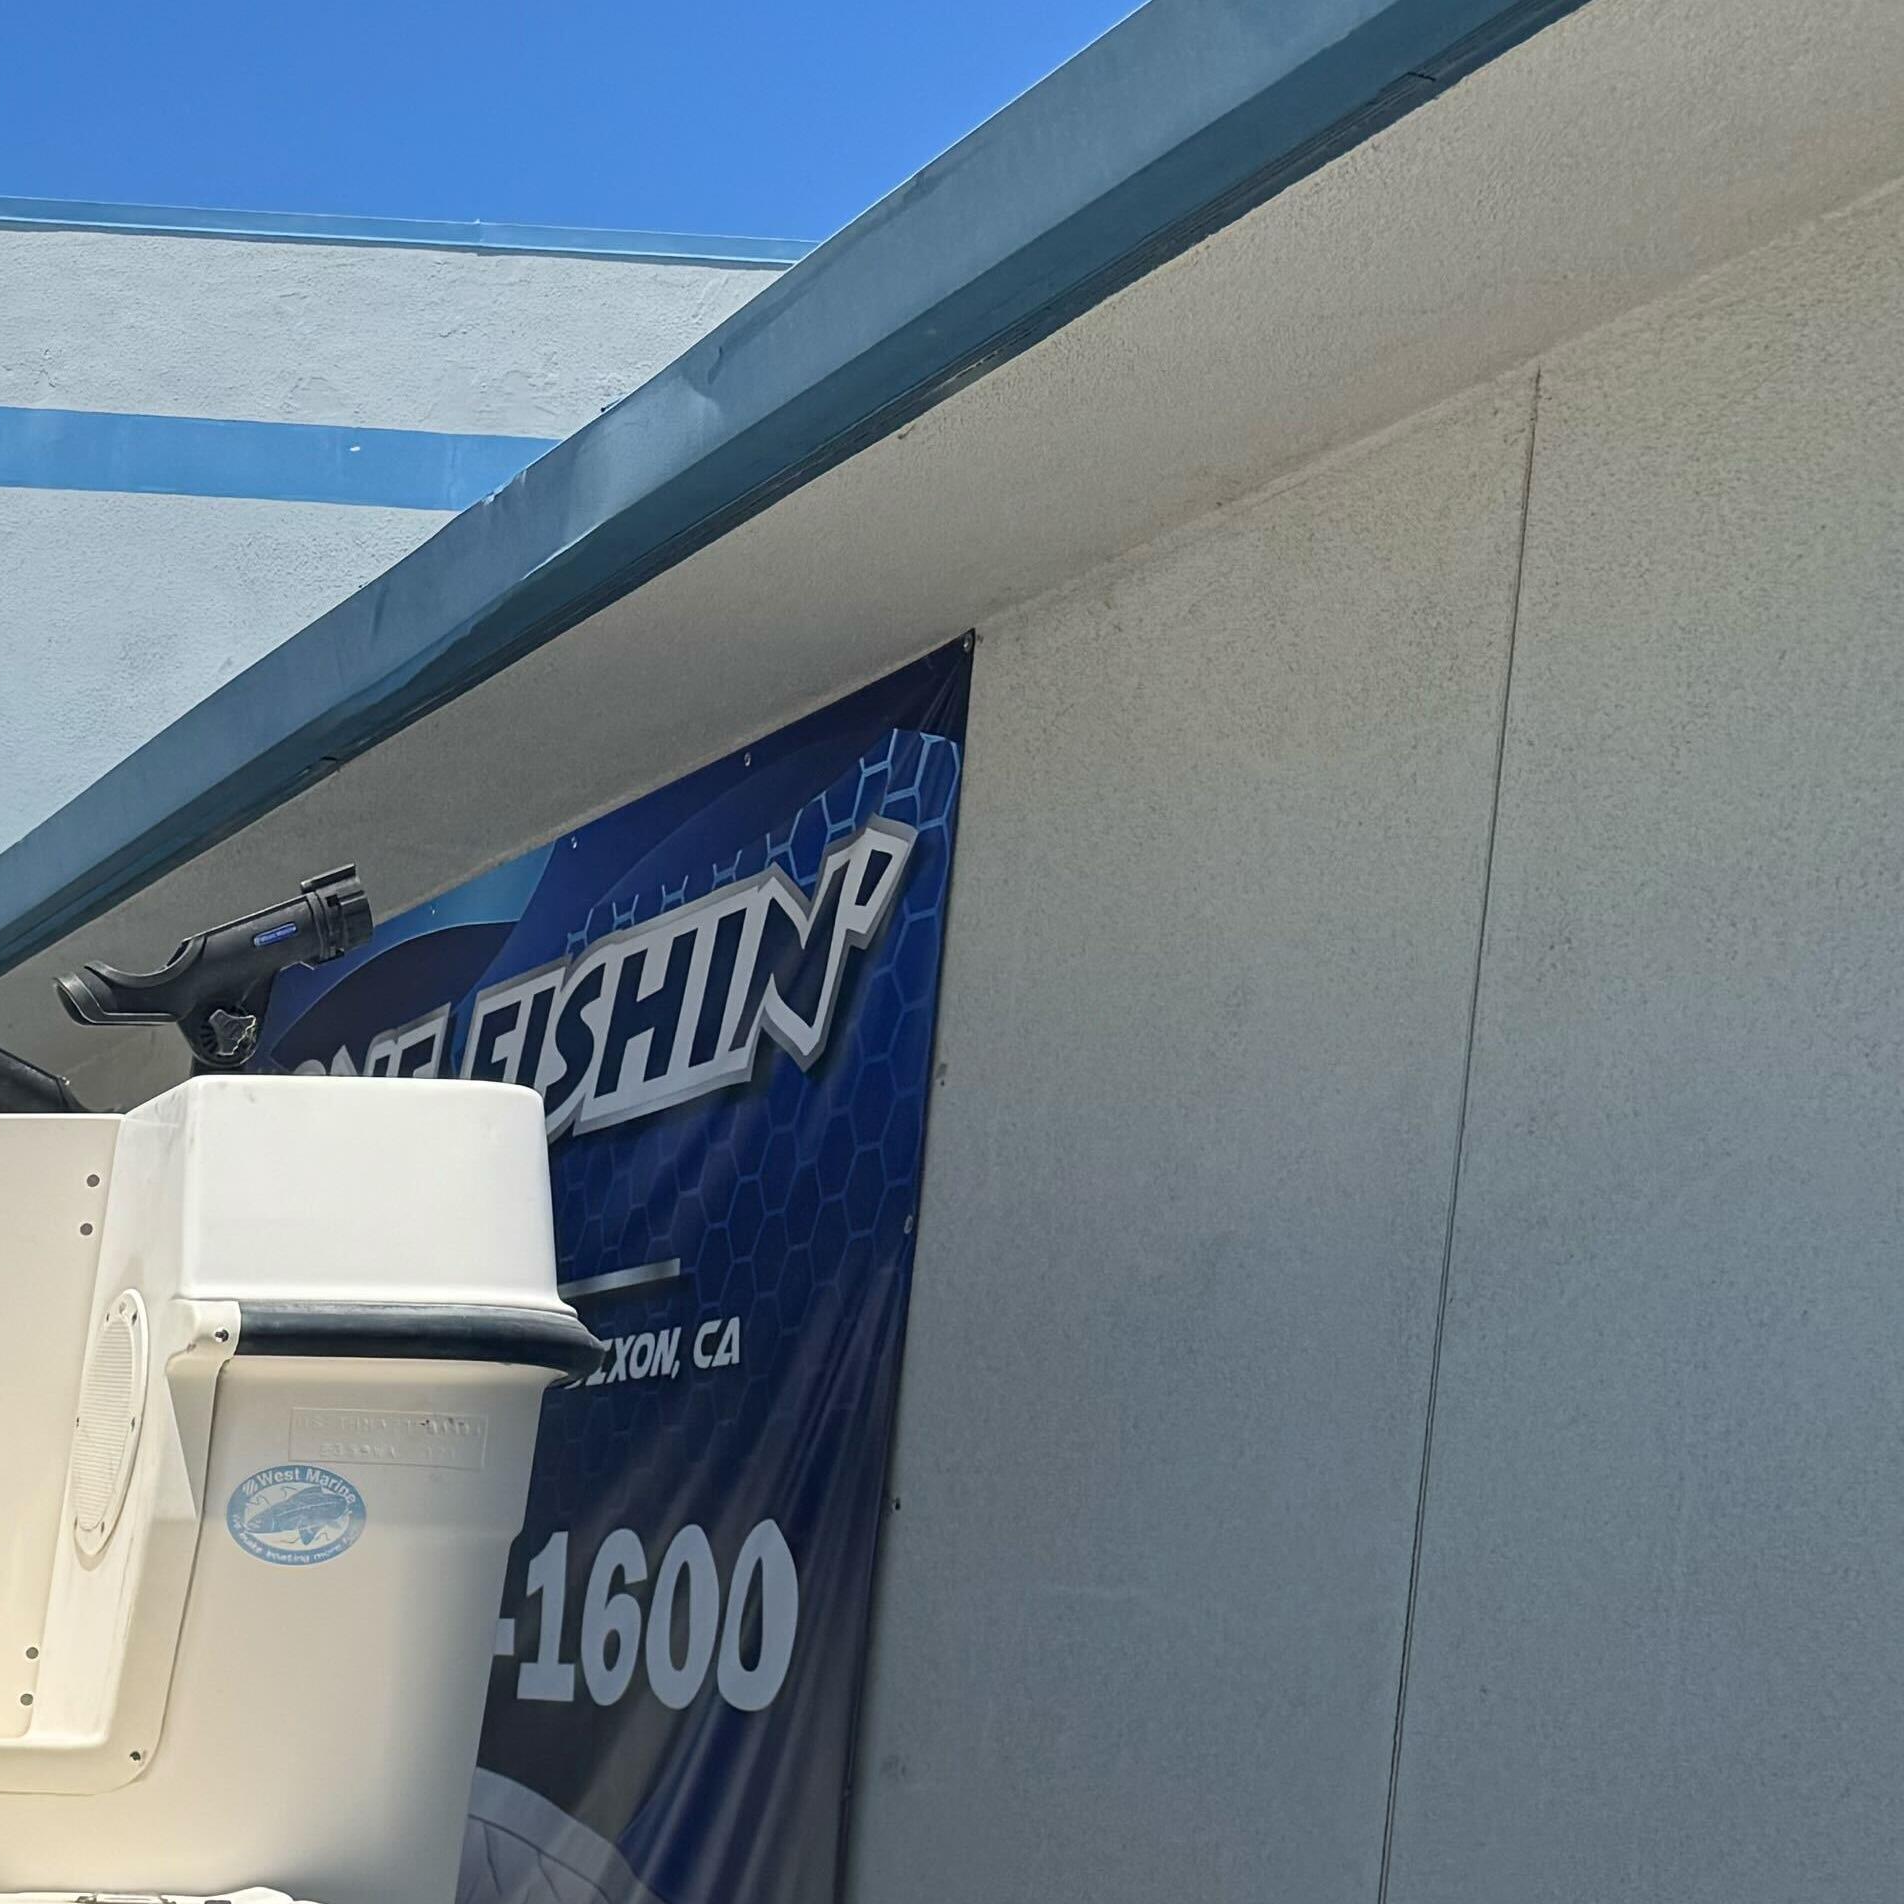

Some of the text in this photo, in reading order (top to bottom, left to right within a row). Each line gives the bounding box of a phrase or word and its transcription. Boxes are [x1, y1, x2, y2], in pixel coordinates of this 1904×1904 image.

[693, 1315, 741, 1370] CA
[256, 1467, 356, 1505] West Marine
